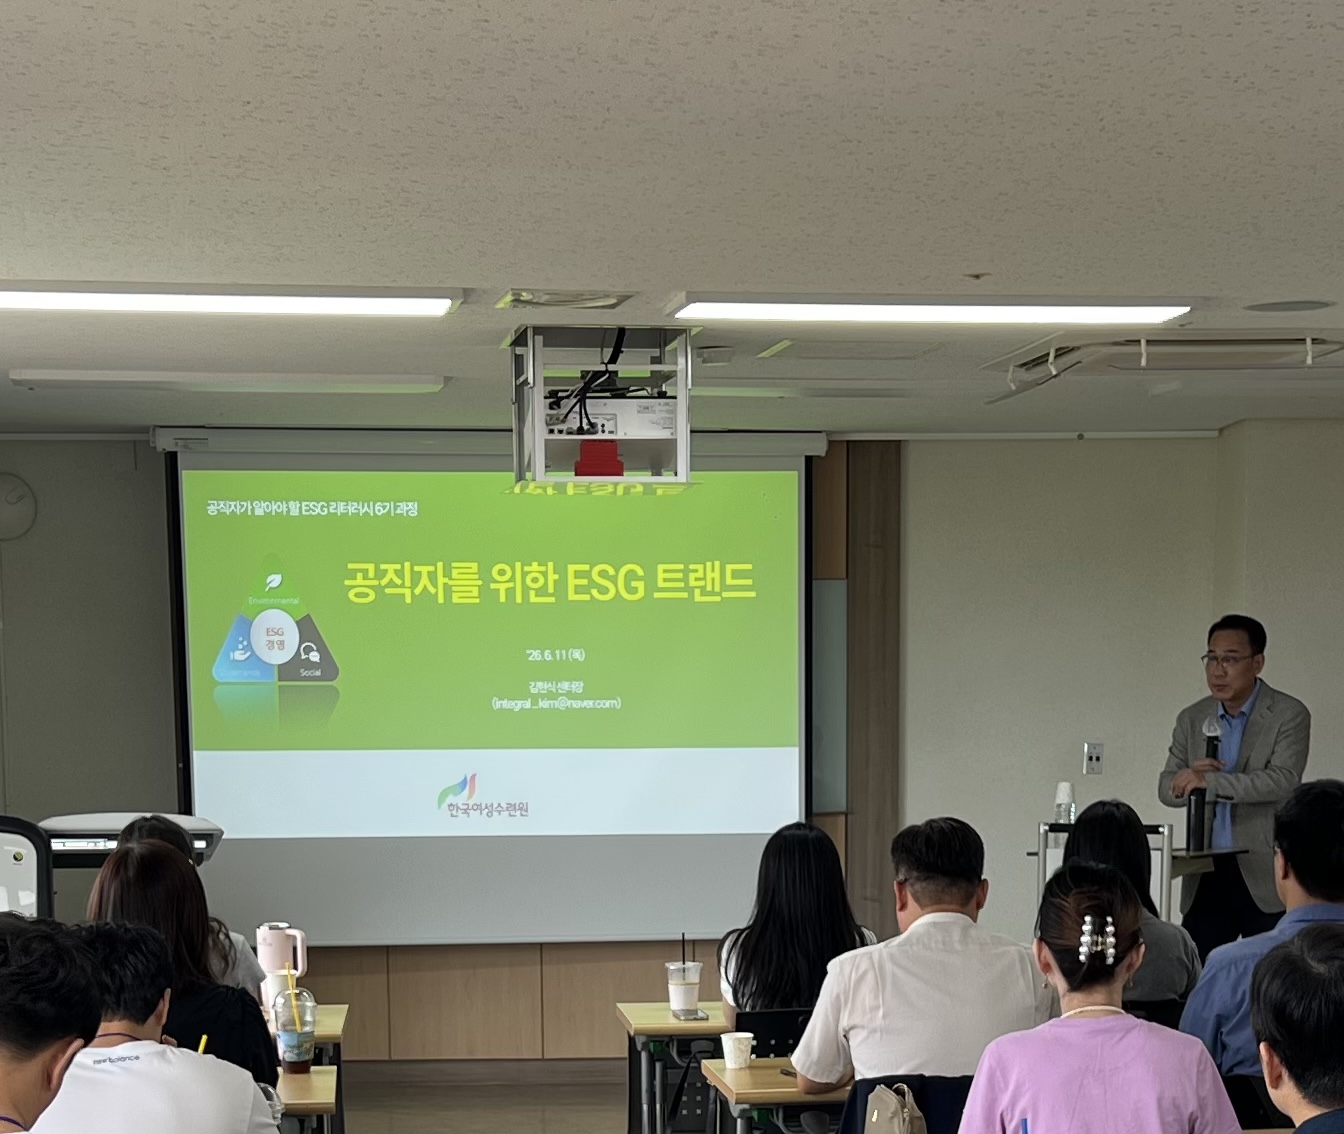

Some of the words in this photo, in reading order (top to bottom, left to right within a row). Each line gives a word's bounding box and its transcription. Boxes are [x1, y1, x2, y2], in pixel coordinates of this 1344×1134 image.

[207, 500, 252, 516] 공직자가
[253, 500, 288, 516] 알아야
[288, 501, 300, 517] 할
[302, 501, 328, 516] ESG
[329, 501, 374, 517] 리터러시
[375, 501, 394, 517] 6기
[395, 501, 418, 517] 과정
[344, 562, 482, 603] 공직자를
[490, 562, 559, 603] 위한
[567, 563, 645, 601] ESG
[653, 560, 756, 602] 트랜드
[266, 628, 284, 637] ESG
[300, 669, 321, 677] Social
[447, 801, 529, 818] 한국여성수련원
